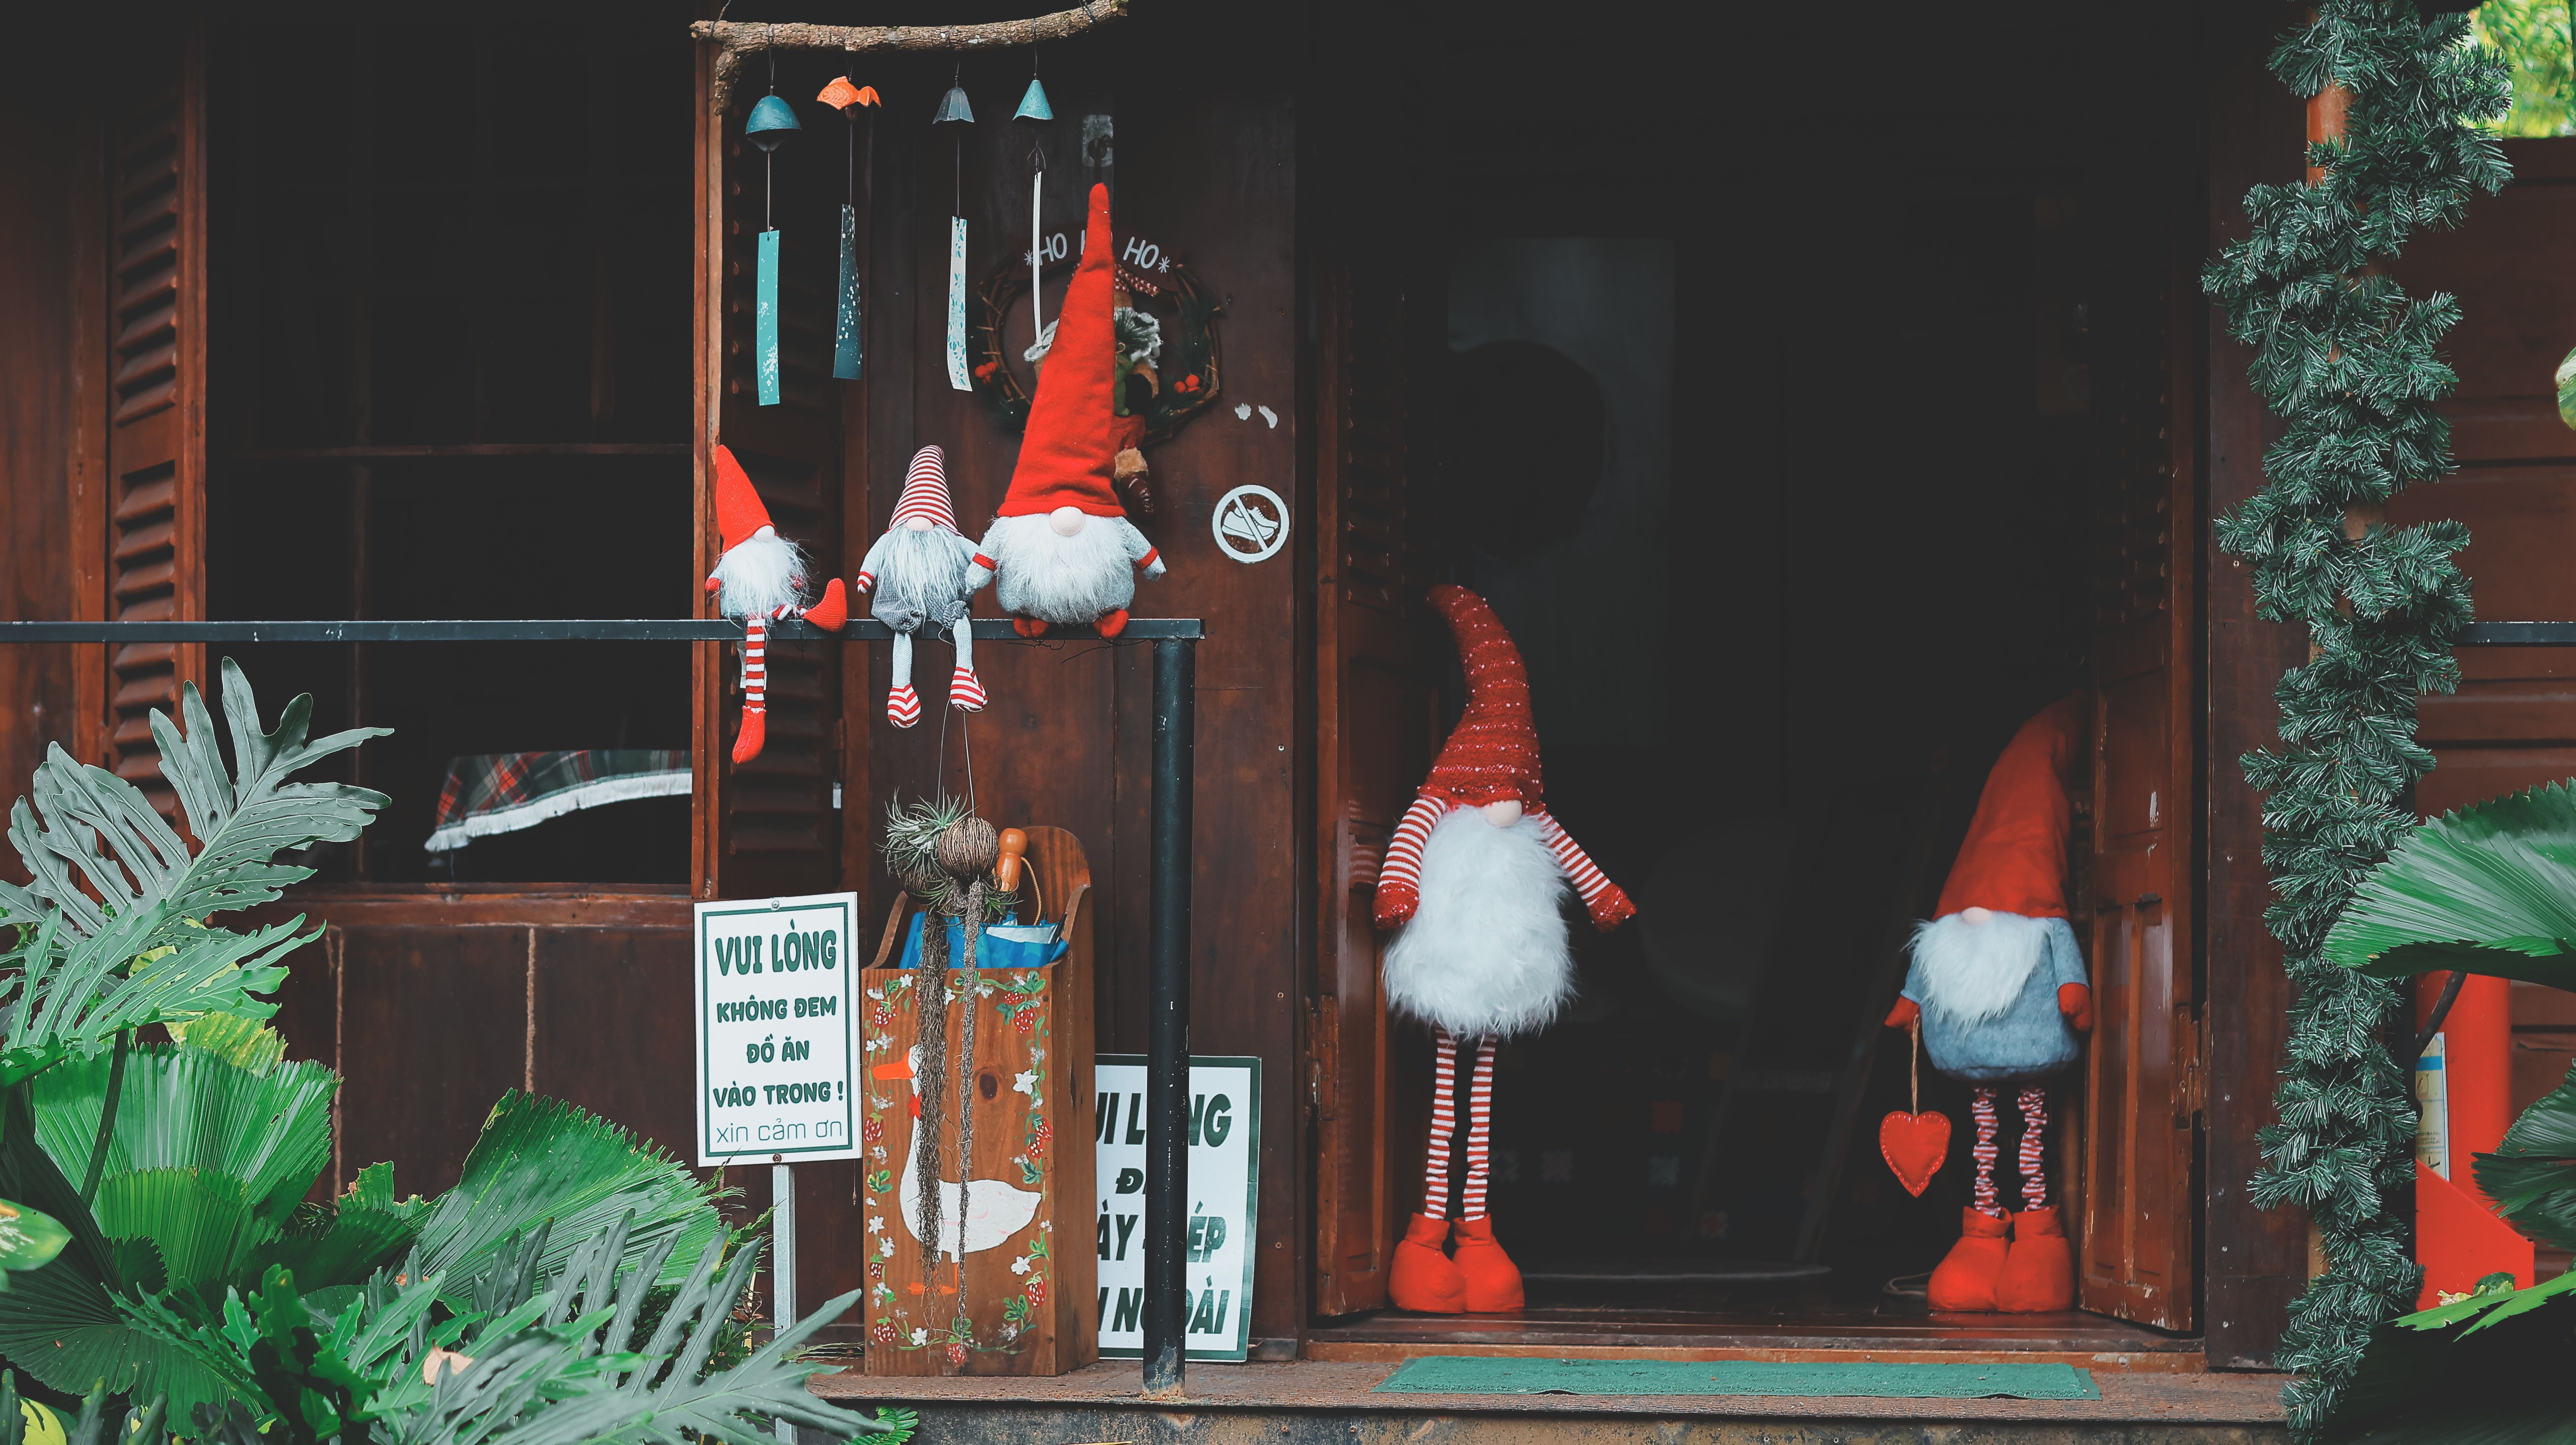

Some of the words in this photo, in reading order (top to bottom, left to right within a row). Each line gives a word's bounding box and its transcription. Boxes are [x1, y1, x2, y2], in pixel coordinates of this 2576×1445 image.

[1039, 233, 1067, 266] HO
[1123, 237, 1159, 269] HO
[715, 935, 762, 976] VUI
[771, 918, 836, 973] LÒNG
[717, 995, 788, 1023] KHÔNG
[794, 995, 836, 1018] ĐEM
[746, 1033, 775, 1064] ĐỒ
[782, 1036, 809, 1062] ĂN
[713, 1080, 756, 1108] VÀO
[763, 1081, 831, 1105] TRONG
[716, 1123, 748, 1143] xin
[758, 1118, 806, 1141] cảm
[816, 1119, 842, 1138] ơn
[1116, 1167, 1146, 1195] Đ
[1187, 1200, 1227, 1263] ÉP
[1111, 1274, 1230, 1334] NÀI
